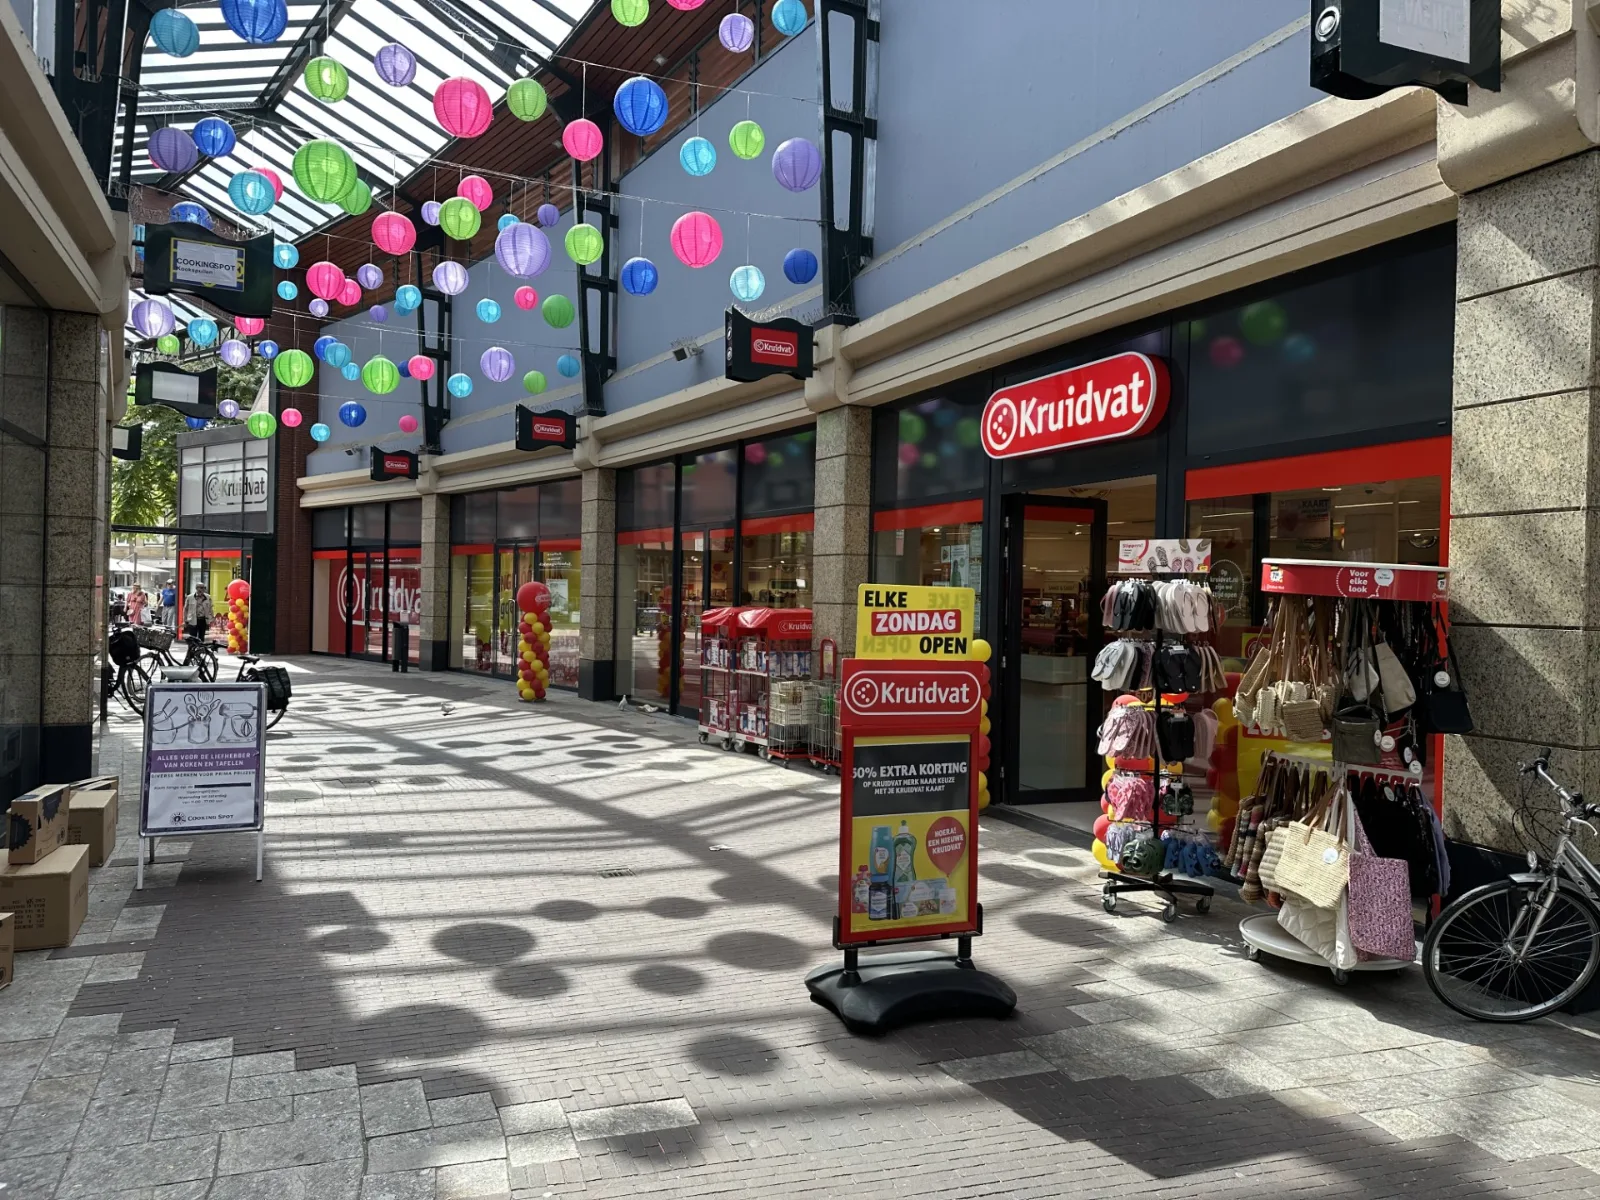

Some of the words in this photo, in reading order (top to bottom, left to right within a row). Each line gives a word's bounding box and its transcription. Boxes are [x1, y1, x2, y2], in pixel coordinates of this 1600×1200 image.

[177, 257, 236, 272] COOKINGSPOT
[764, 342, 792, 353] Kruidvat
[1019, 371, 1145, 438] Kruidvat
[220, 476, 265, 497] Kruidvat
[1349, 569, 1369, 577] Voor
[1349, 577, 1368, 585] elke
[1348, 585, 1368, 593] look
[864, 590, 908, 608] ELKE
[788, 622, 812, 631] Kruidva
[875, 611, 957, 633] ZONDAG
[919, 636, 968, 654] OPEN
[881, 681, 970, 704] Kruidvat
[157, 753, 179, 761] ALLES
[852, 766, 877, 779] 50%
[879, 764, 917, 778] EXTRA
[919, 761, 968, 775] KORTING
[872, 779, 903, 787] KRUIDVAT
[902, 778, 919, 786] MERK
[920, 777, 937, 785] NAAR
[937, 776, 955, 784] KEUZE
[895, 786, 925, 794] KRUIDVAT
[925, 785, 945, 793] KAART
[934, 826, 957, 837] HOERA!
[928, 838, 940, 847] EEN
[940, 834, 964, 845] NIEUWE
[932, 842, 962, 855] KRUIDVAT
